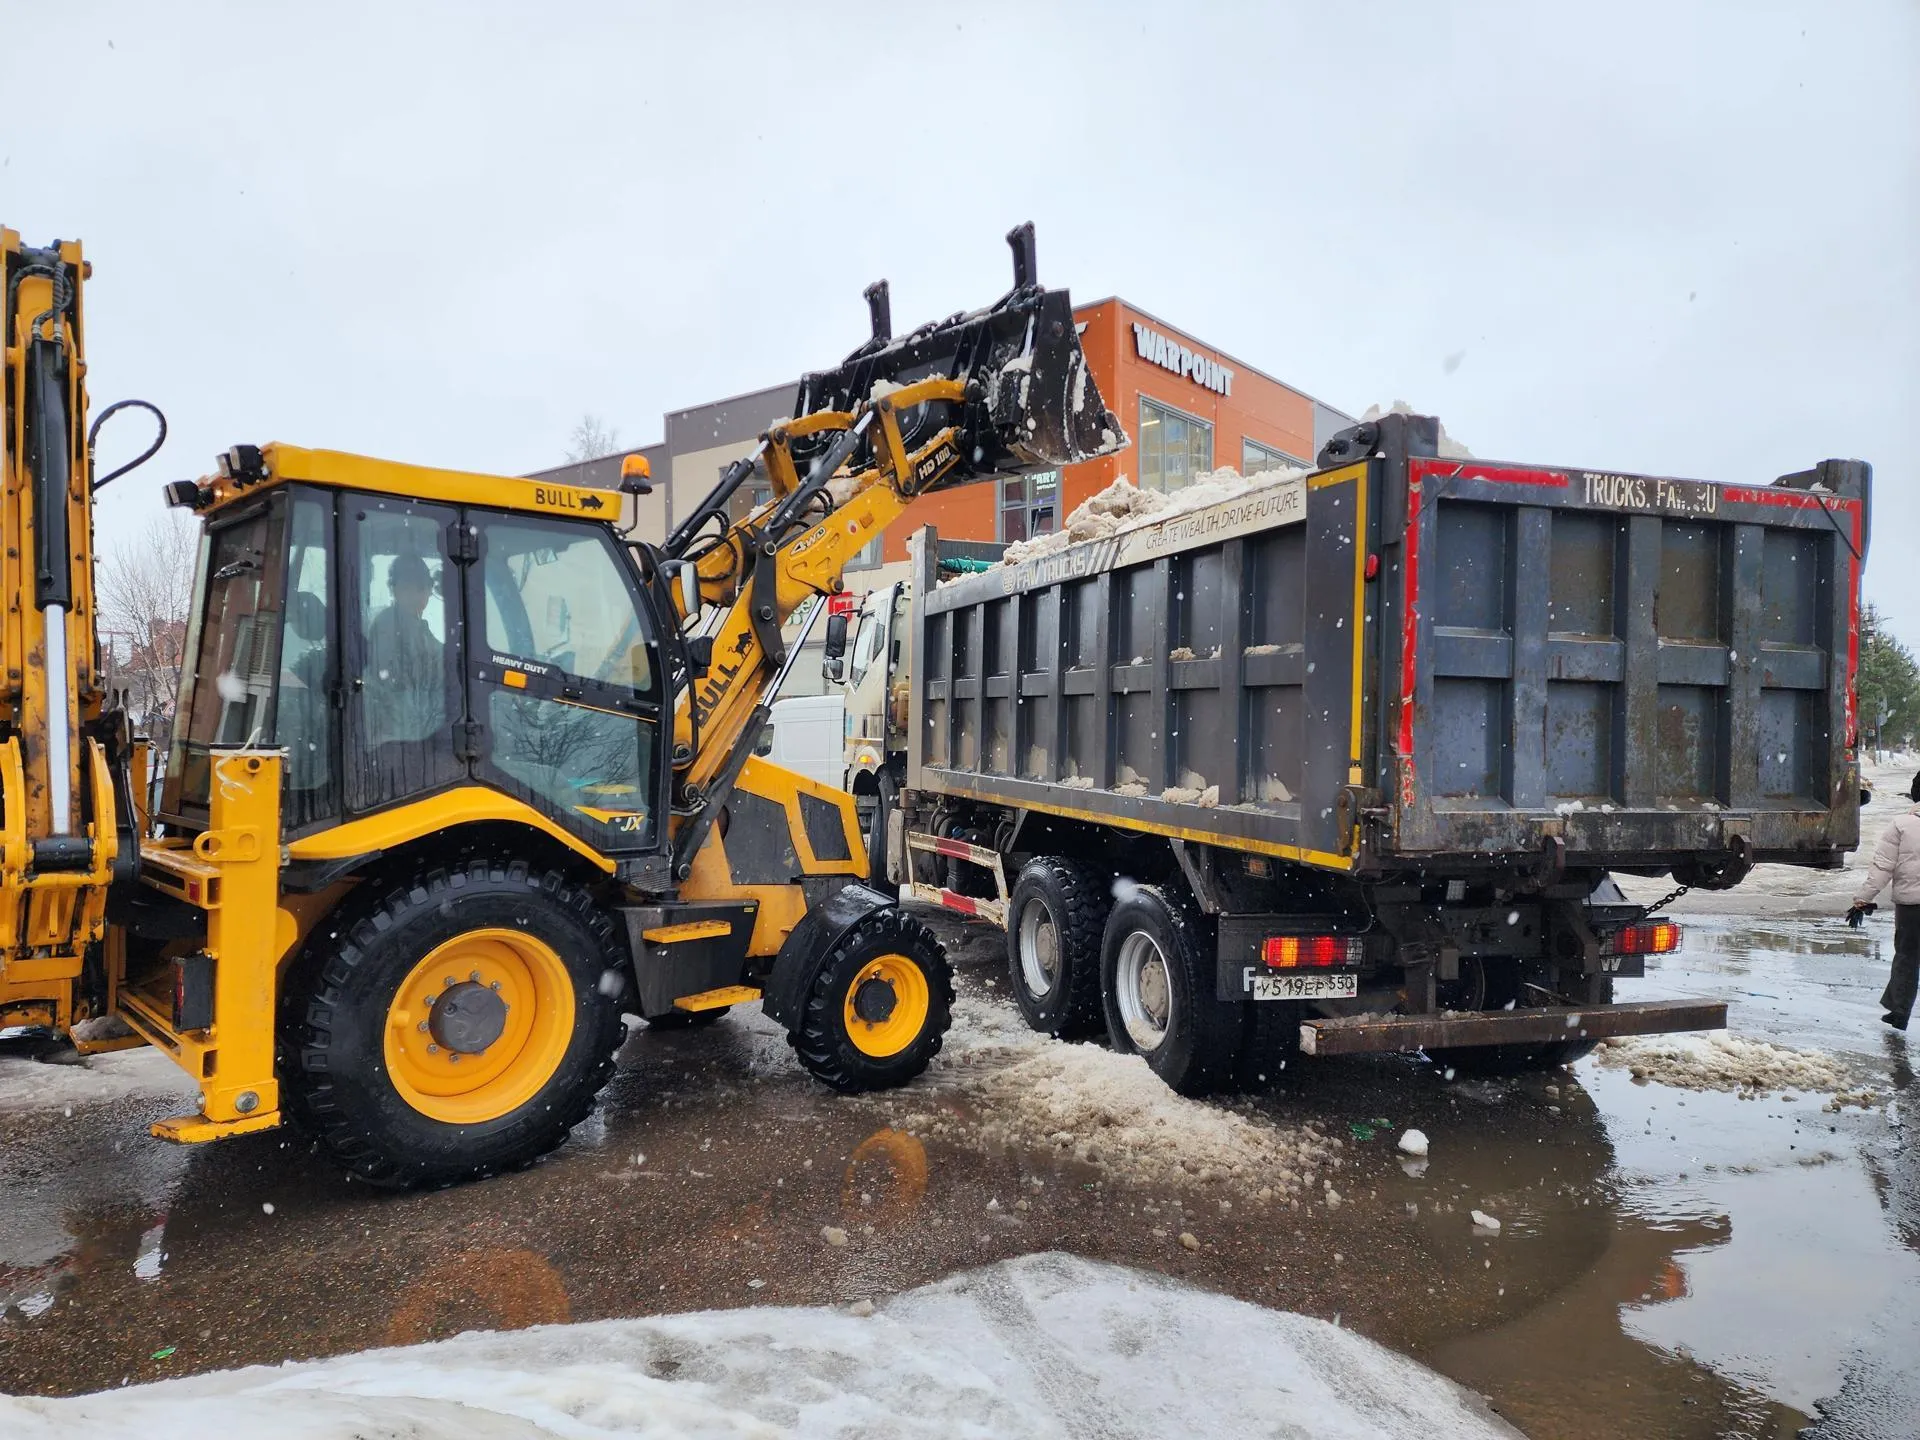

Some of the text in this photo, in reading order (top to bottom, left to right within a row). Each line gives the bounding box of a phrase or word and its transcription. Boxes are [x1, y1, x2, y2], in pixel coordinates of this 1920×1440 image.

[1132, 322, 1234, 397] WARPOINT
[918, 445, 951, 480] HD 100
[535, 488, 576, 509] BULL
[1146, 526, 1178, 550] CREATE
[1221, 503, 1254, 529] DRIVE
[1255, 489, 1299, 517] FUTURE
[1016, 551, 1087, 590] FAW TRUCKS
[492, 655, 549, 675] HEAVY DUTY
[687, 663, 739, 729] BULL
[620, 816, 645, 832] JX
